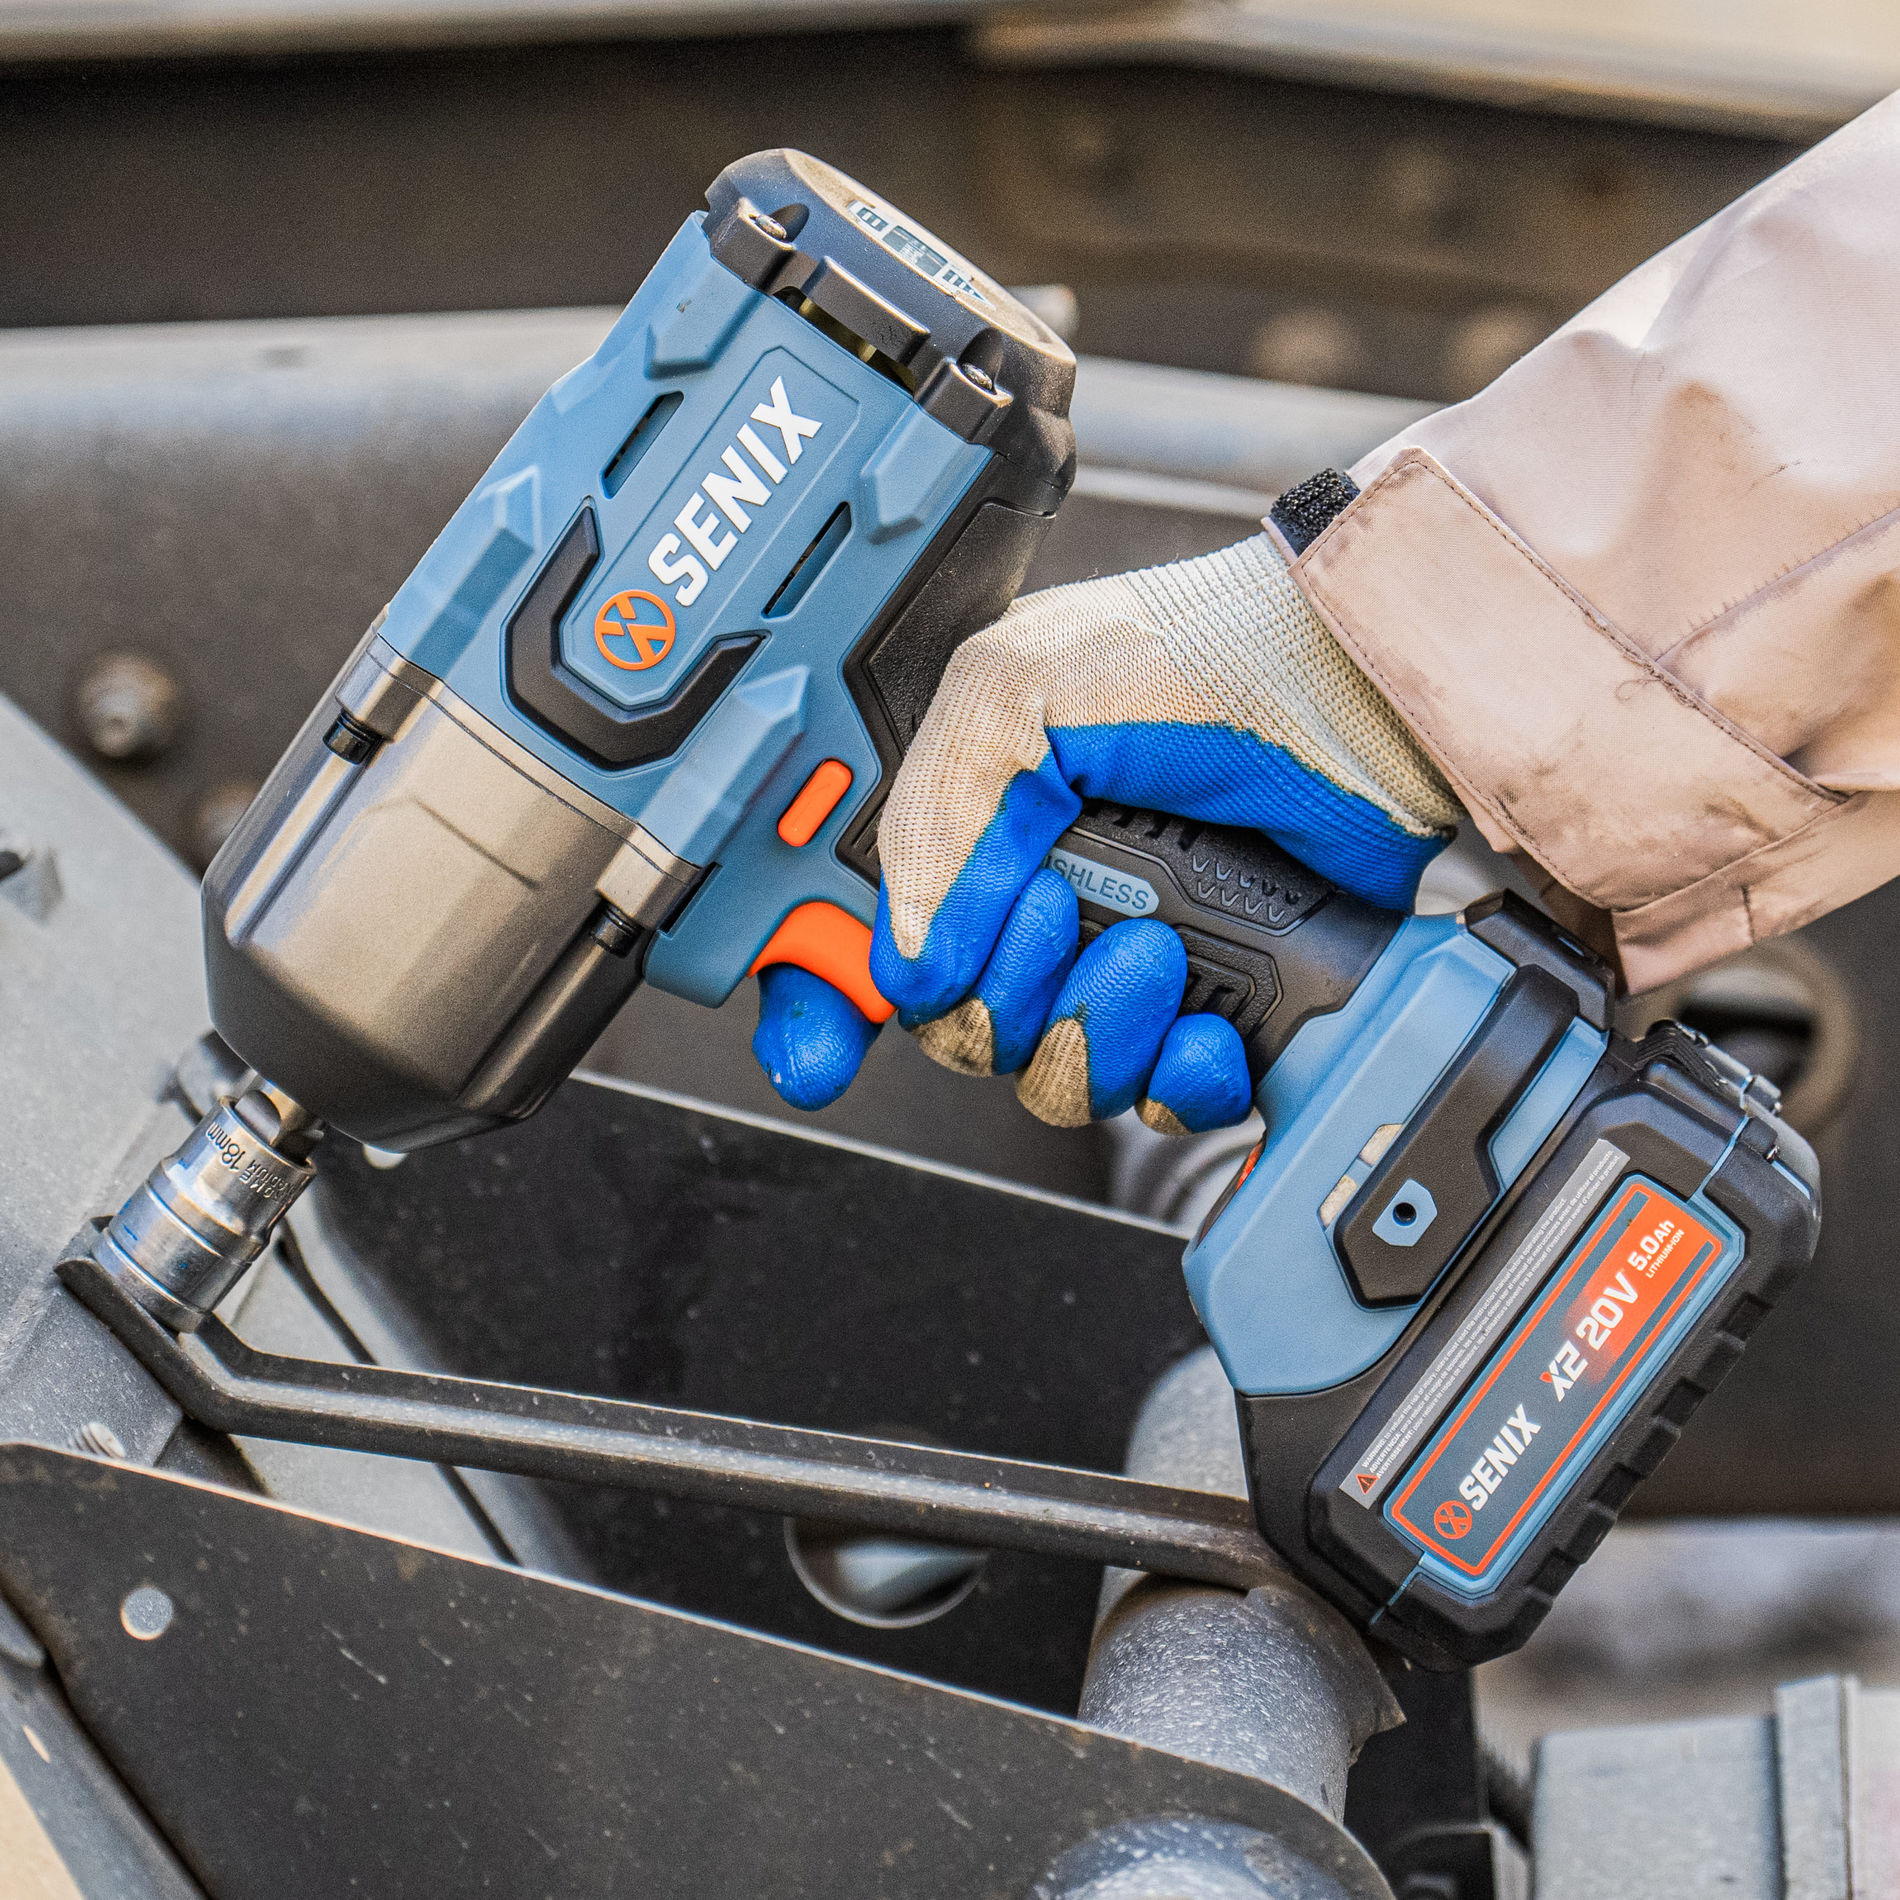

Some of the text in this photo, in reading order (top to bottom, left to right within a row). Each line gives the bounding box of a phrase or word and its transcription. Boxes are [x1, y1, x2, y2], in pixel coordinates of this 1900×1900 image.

[648, 375, 823, 607] SENIX
[206, 1121, 246, 1172] 18mm
[1645, 1228, 1684, 1278] LITHIUM-ION
[1458, 1220, 1675, 1511] SENIX X2 20V 5.0Ah
